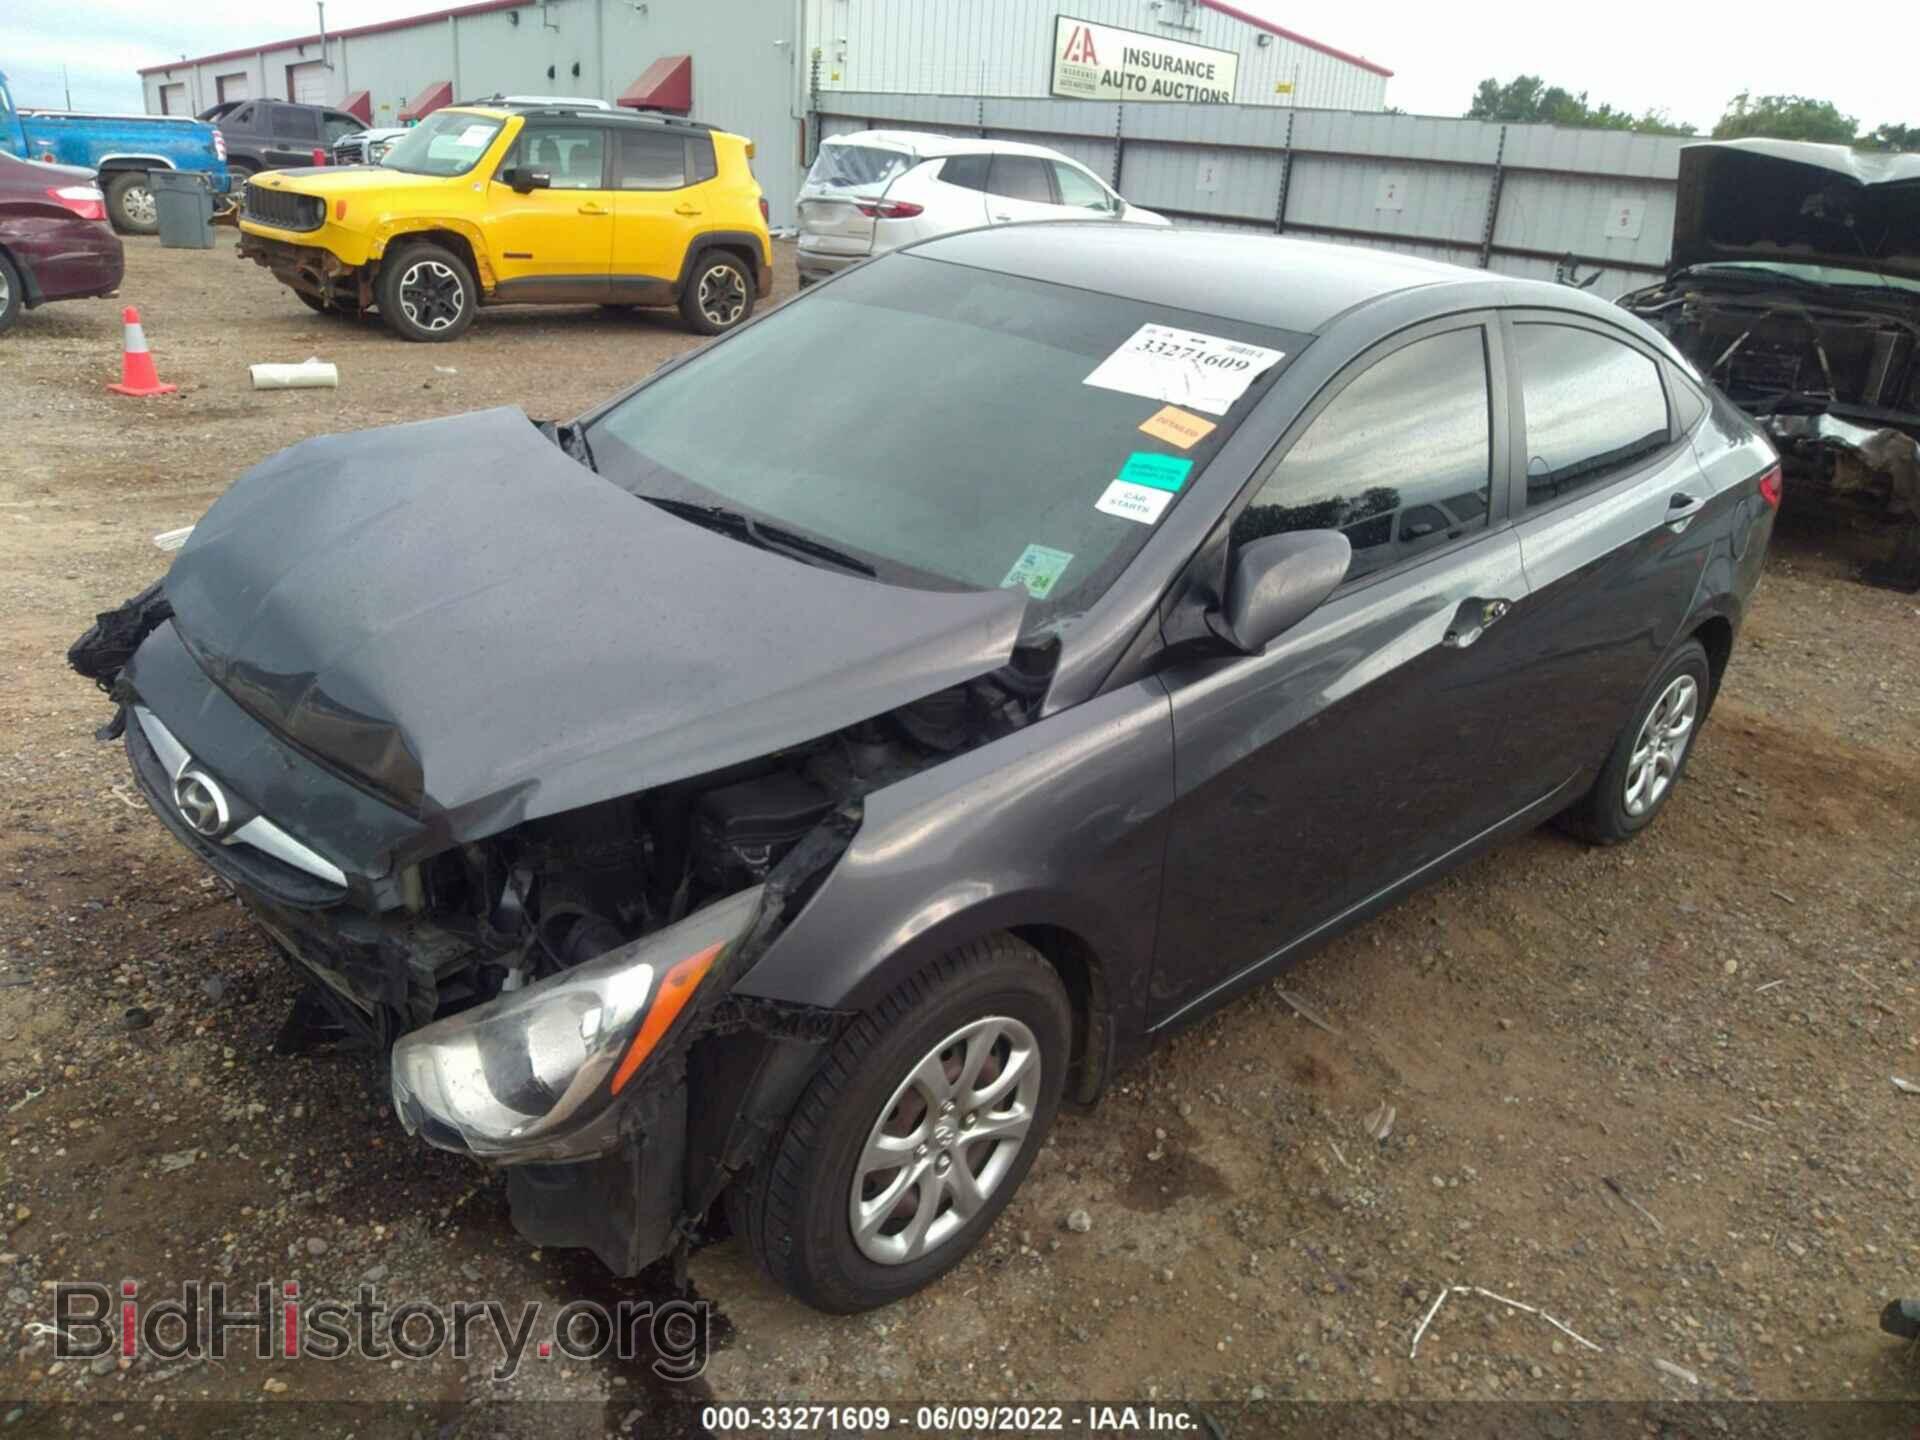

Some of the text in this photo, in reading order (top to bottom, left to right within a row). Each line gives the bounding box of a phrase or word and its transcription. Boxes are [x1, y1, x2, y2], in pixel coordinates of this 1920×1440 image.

[1123, 47, 1216, 80] INSURANCE
[1101, 69, 1230, 103] AUTO AUCTIONS
[1136, 339, 1250, 371] 33271609
[1122, 491, 1147, 503] CAR
